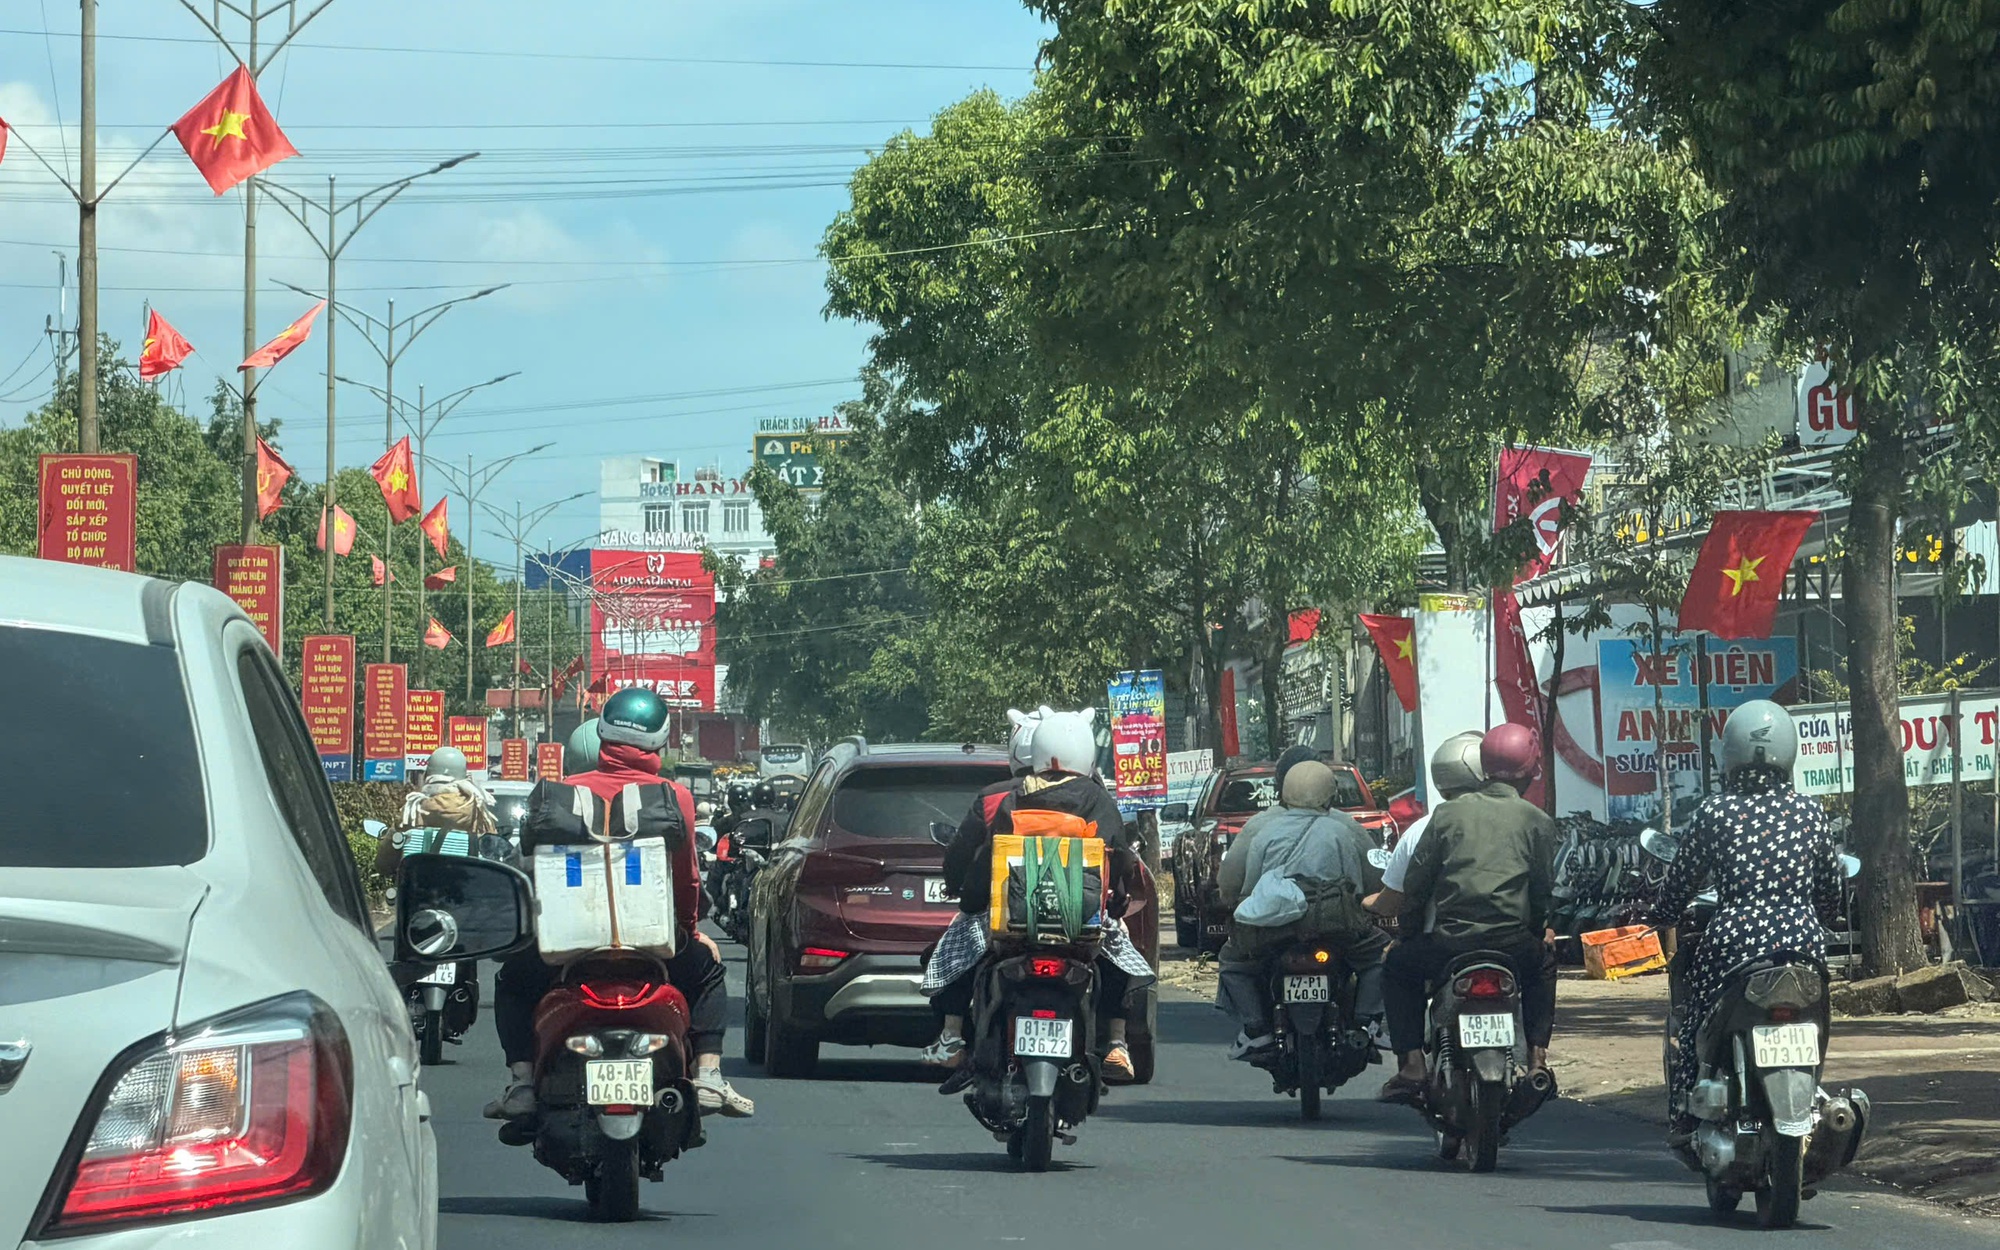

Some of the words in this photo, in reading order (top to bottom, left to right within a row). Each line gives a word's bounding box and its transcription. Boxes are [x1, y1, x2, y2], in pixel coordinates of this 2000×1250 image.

[760, 416, 789, 431] KHÁCH
[61, 465, 82, 479] CHỦ
[84, 467, 114, 481] ĐỘNG,
[61, 482, 91, 495] QUYẾT
[94, 483, 114, 496] LIỆT
[640, 481, 675, 497] Hotel
[1632, 650, 1680, 686] XE
[1616, 748, 1658, 773] SỬA
[1974, 754, 1992, 772] RA
[1290, 976, 1321, 988] 47-P1
[1018, 1037, 1068, 1055] 036.22
[1463, 1030, 1511, 1045] 054.41
[1759, 1046, 1815, 1064] 073.12
[597, 1063, 643, 1082] 48-AF
[591, 1083, 649, 1104] 046.68
